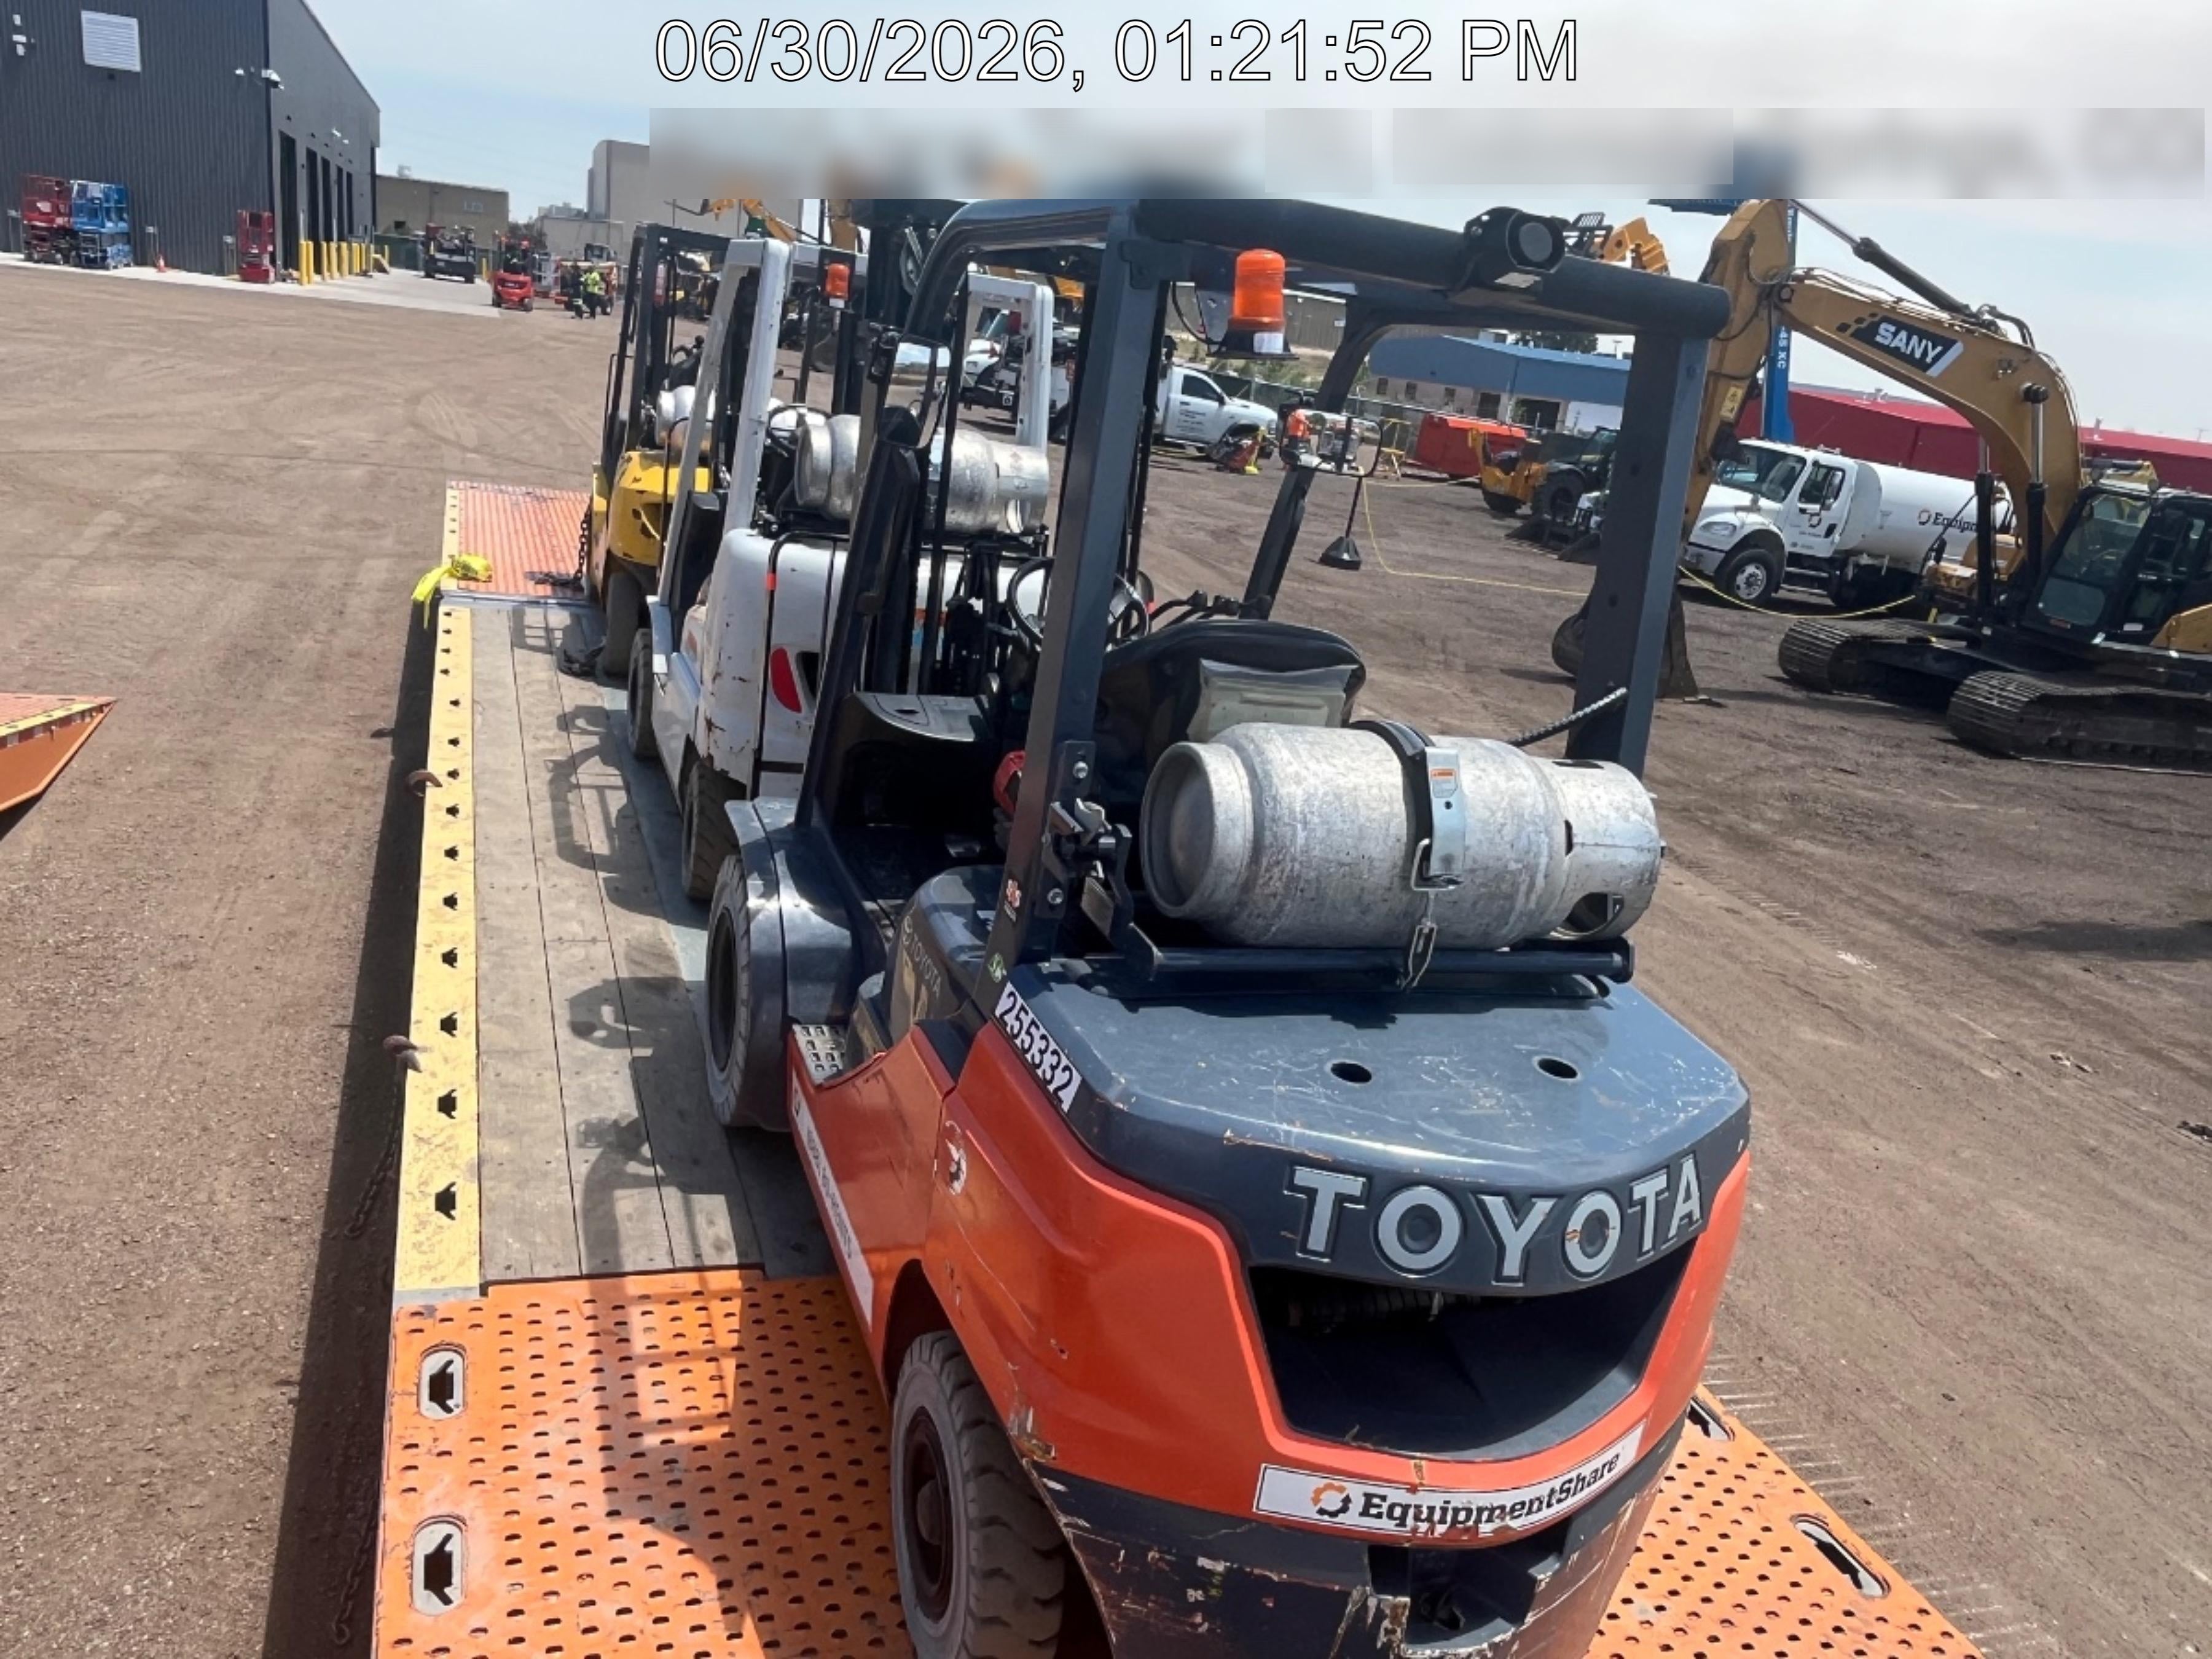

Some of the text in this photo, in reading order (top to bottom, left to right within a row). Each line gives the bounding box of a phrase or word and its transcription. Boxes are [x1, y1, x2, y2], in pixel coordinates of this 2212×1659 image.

[1875, 321, 1943, 363] SANY
[998, 990, 1073, 1104] 255332
[1284, 1153, 1703, 1286] TOYOTA
[1358, 1452, 1620, 1529] EquipmentShare
